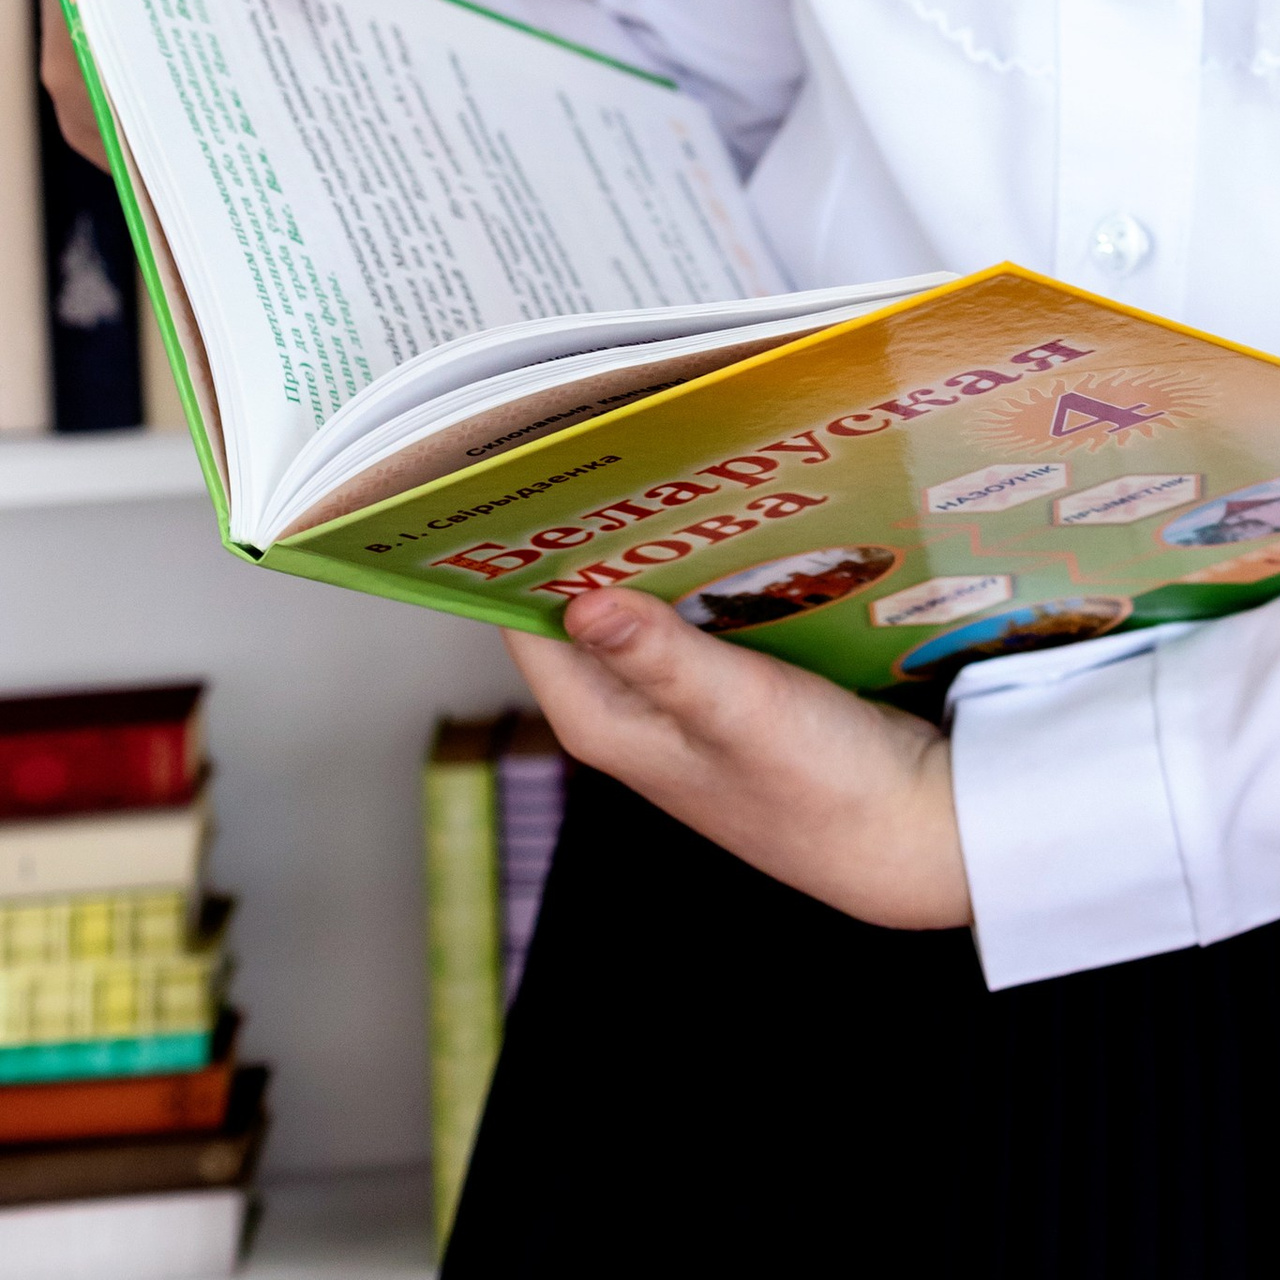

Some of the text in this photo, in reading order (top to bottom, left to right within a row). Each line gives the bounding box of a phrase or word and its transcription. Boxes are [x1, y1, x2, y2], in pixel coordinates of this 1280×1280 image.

[244, 251, 287, 349] ветлівым
[301, 254, 338, 328] формы
[327, 270, 363, 350] літары.
[291, 327, 309, 354] да
[279, 353, 301, 405] Пры
[299, 362, 326, 431] энне)
[1048, 391, 1165, 439] 4
[430, 338, 1097, 581] Беларуская
[465, 404, 593, 458] Склонавыя
[364, 542, 402, 554] В.
[427, 454, 622, 530] Свірыдзенка
[530, 490, 830, 603] мова
